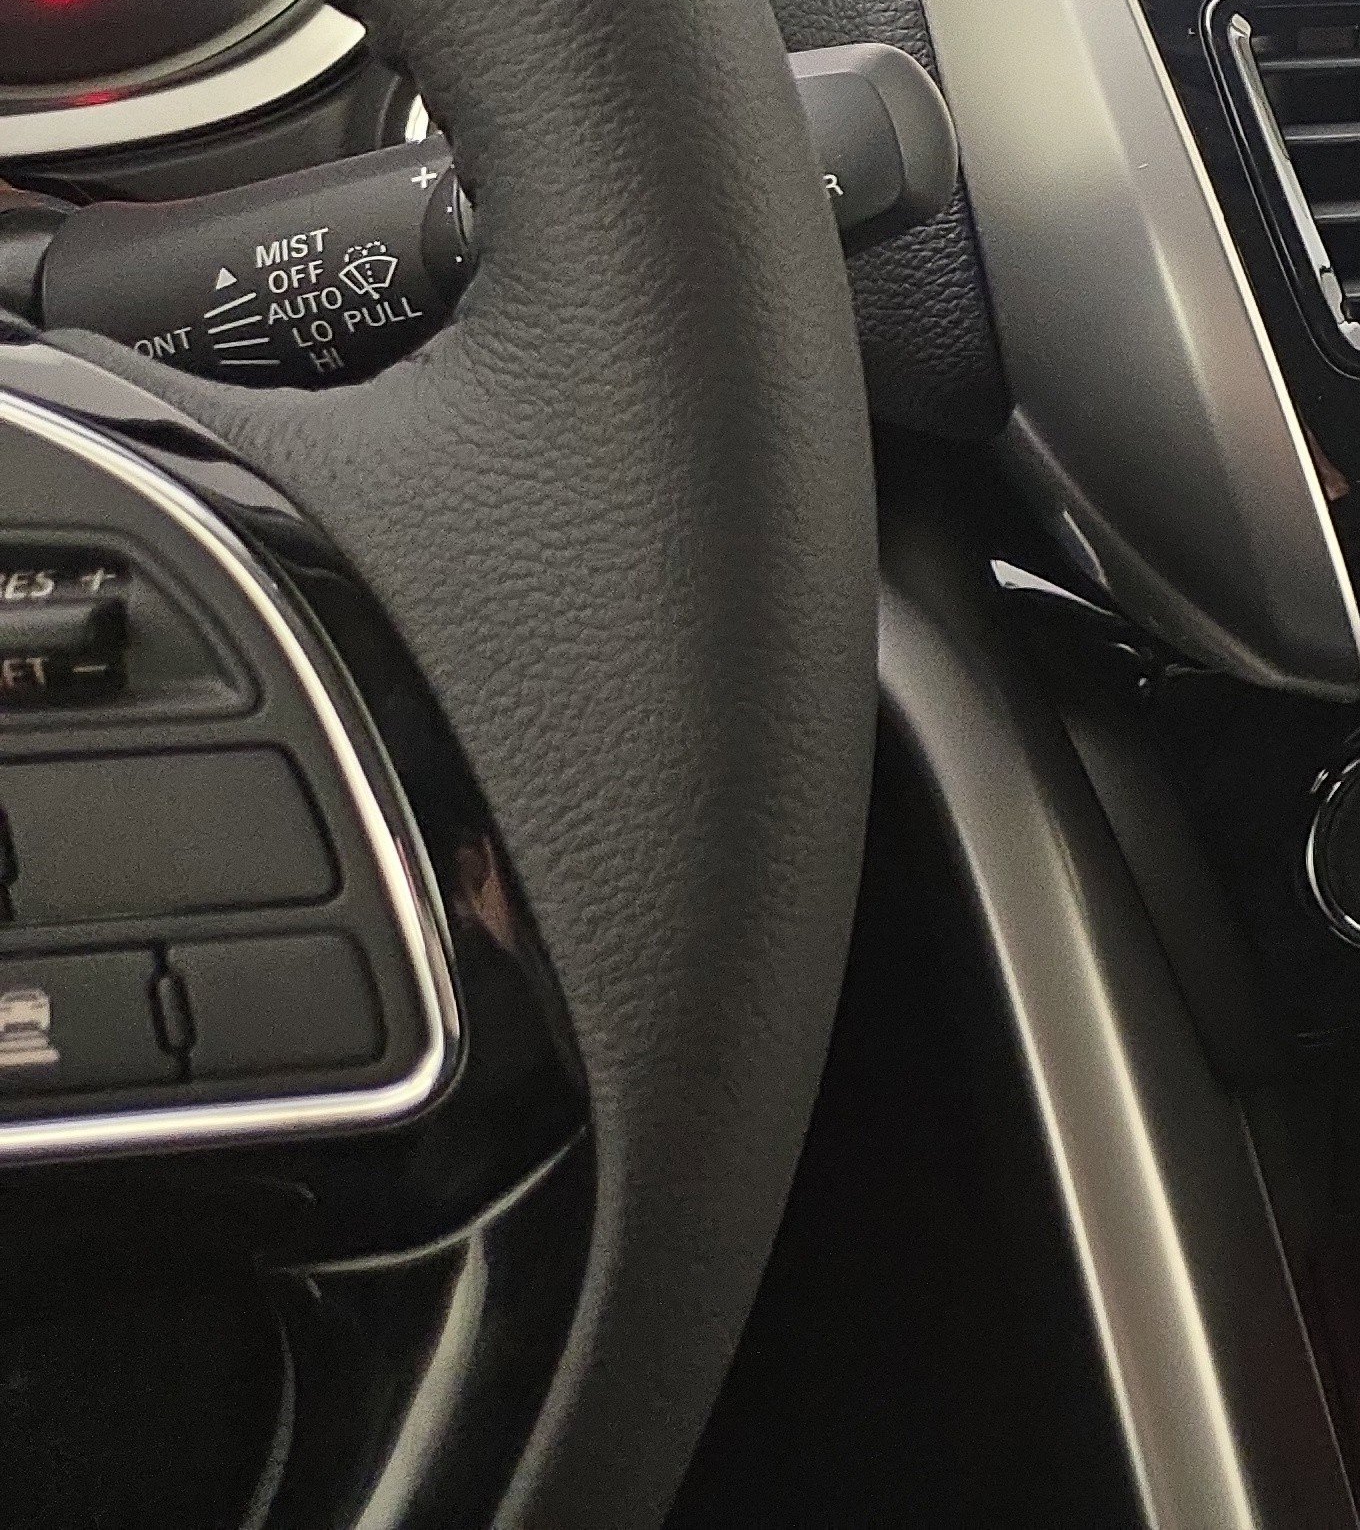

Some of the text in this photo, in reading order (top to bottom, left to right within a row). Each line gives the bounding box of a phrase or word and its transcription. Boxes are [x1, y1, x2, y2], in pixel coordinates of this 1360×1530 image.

[255, 228, 329, 268] MIST
[268, 260, 324, 293] OFF
[268, 287, 342, 325] AUTO
[344, 297, 423, 332] PULL
[292, 321, 333, 348] LO
[310, 347, 345, 372] HI
[0, 570, 56, 601] ES
